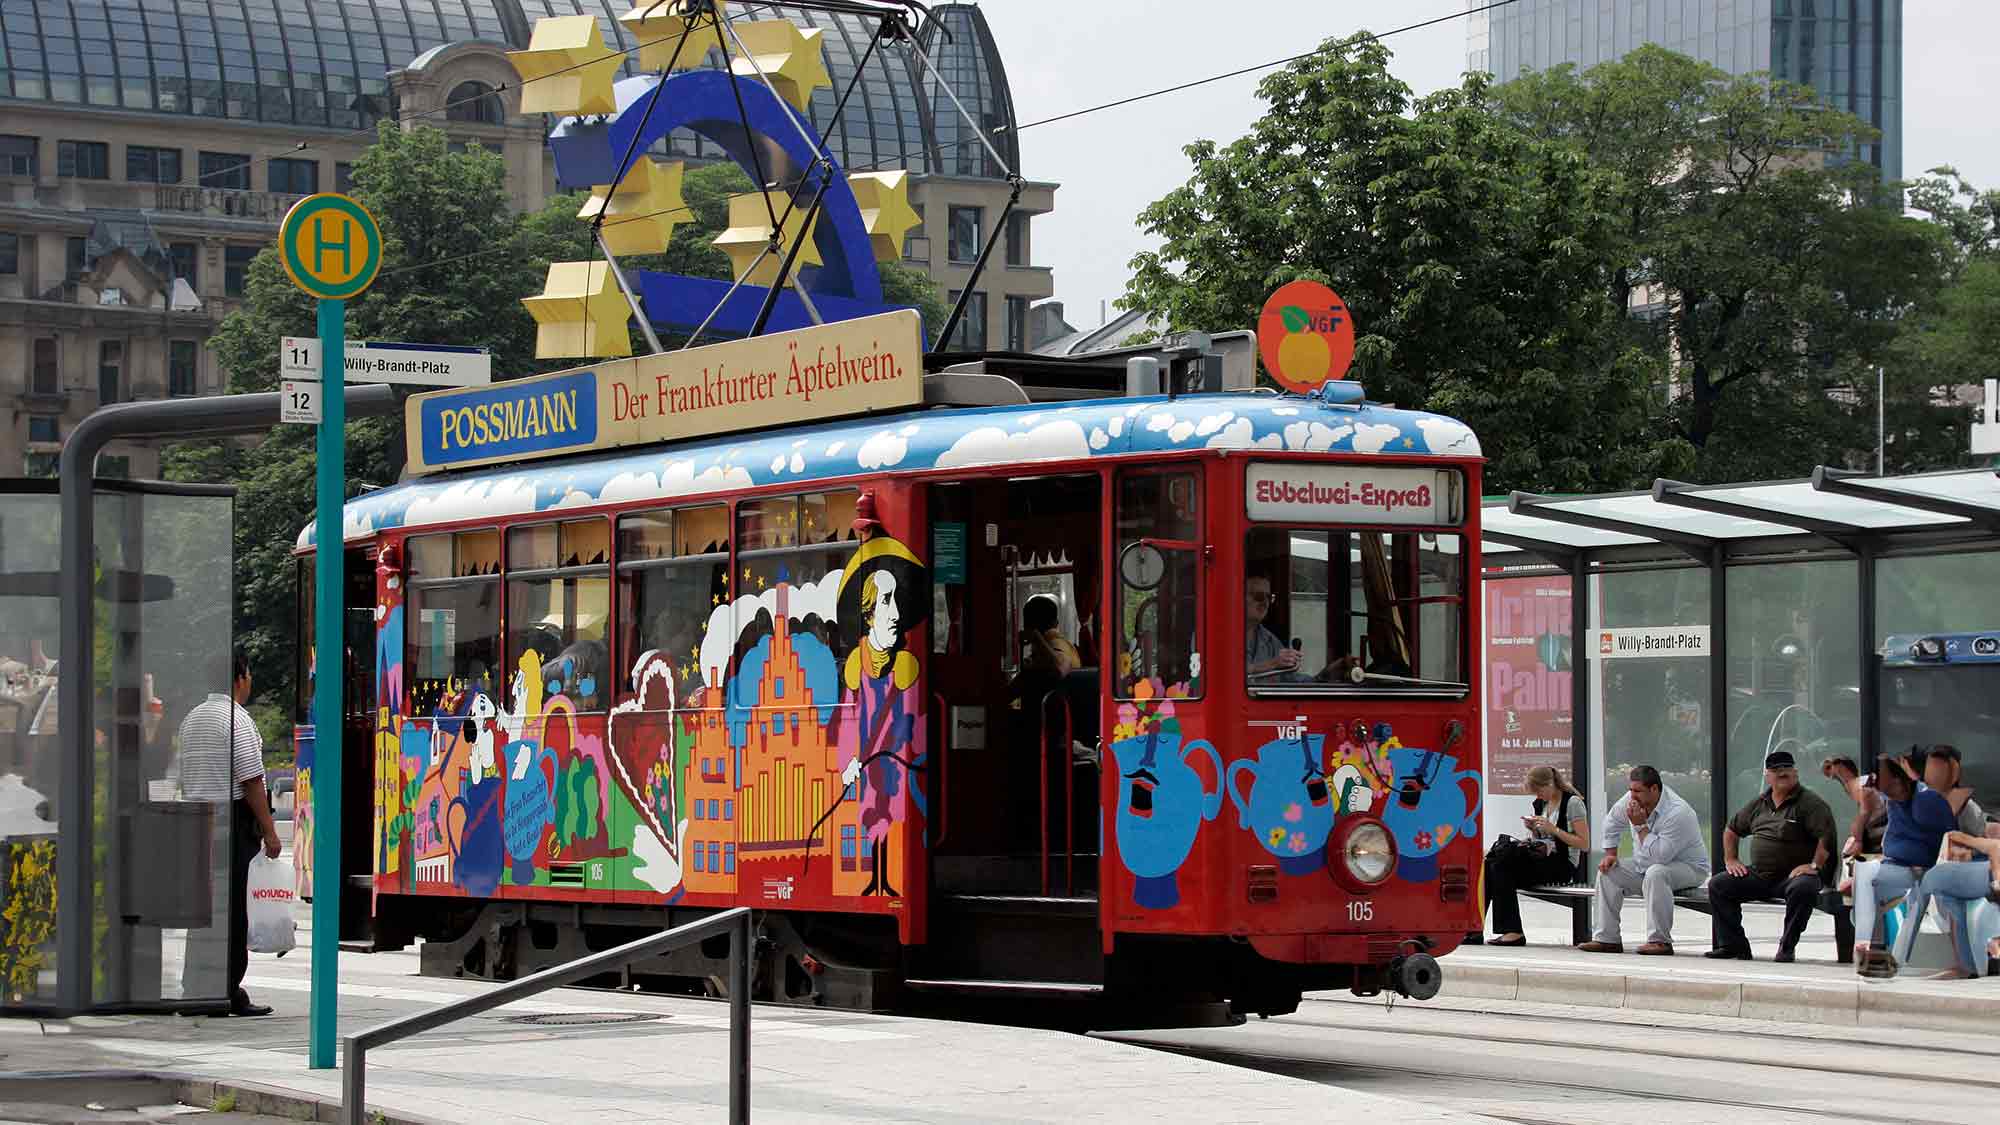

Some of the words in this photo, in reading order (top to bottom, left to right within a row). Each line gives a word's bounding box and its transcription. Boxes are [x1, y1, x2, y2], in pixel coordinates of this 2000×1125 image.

[314, 217, 350, 275] H
[1309, 306, 1342, 332] VGF
[291, 348, 309, 366] 11
[344, 358, 450, 375] Willy-Brandt-Platz
[612, 382, 648, 422] Der
[655, 364, 777, 416] Frankfurter
[785, 341, 903, 401] Äpfelwein.
[291, 393, 310, 410] 12
[441, 389, 577, 450] POSSMANN
[1256, 480, 1432, 512] Ebbelwei-Expreß
[1618, 634, 1702, 652] Willy-Brandt-Platz
[1277, 718, 1308, 739] VGF
[592, 863, 604, 881] 105
[1346, 901, 1373, 921] 105
